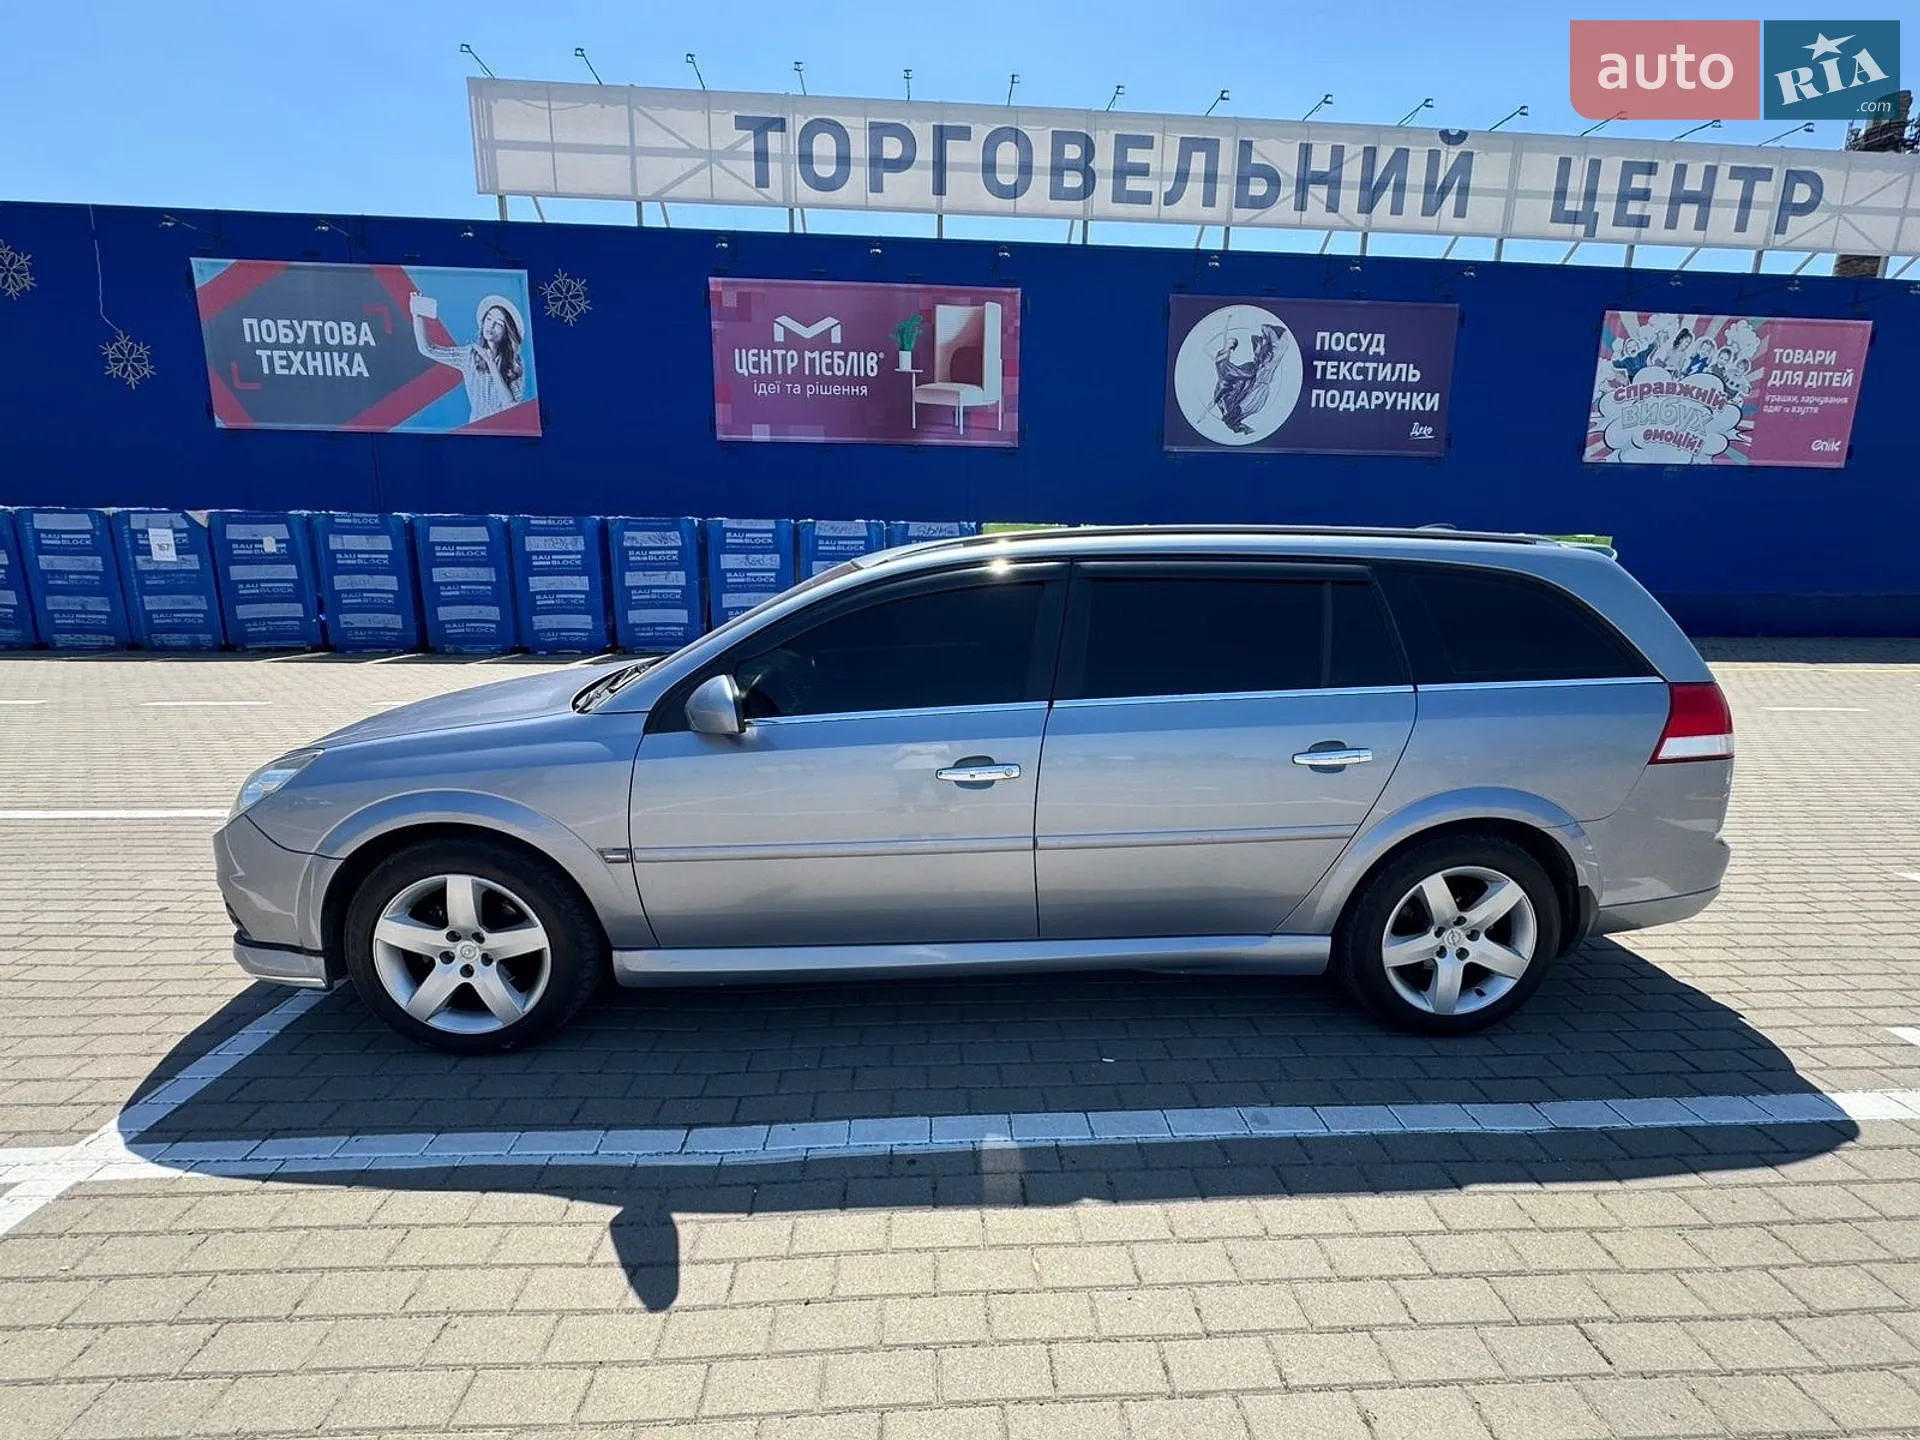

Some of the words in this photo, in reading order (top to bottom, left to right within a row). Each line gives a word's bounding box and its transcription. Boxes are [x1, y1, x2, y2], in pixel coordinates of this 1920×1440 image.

[734, 115, 1474, 219] ТОРГОВЕЛЬНИЙ
[1550, 155, 1824, 239] ЦЕНТР
[242, 318, 376, 346] ПОБУТОВА
[1315, 331, 1385, 355] ПОСУД
[256, 349, 370, 377] ТЕХНІКА
[734, 348, 798, 376] ЦЕНТР
[1773, 348, 1837, 365] ТОВАРИ
[1313, 361, 1421, 382] ТЕКСТИЛЬ
[1767, 369, 1803, 388] ДЛЯ
[1804, 368, 1854, 389] ДІТЕЙ
[753, 379, 780, 396] ідеї
[785, 382, 800, 394] та
[806, 381, 868, 398] рішення
[1311, 389, 1440, 412] ПОДАРУНКИ
[1613, 381, 1728, 410] справжній
